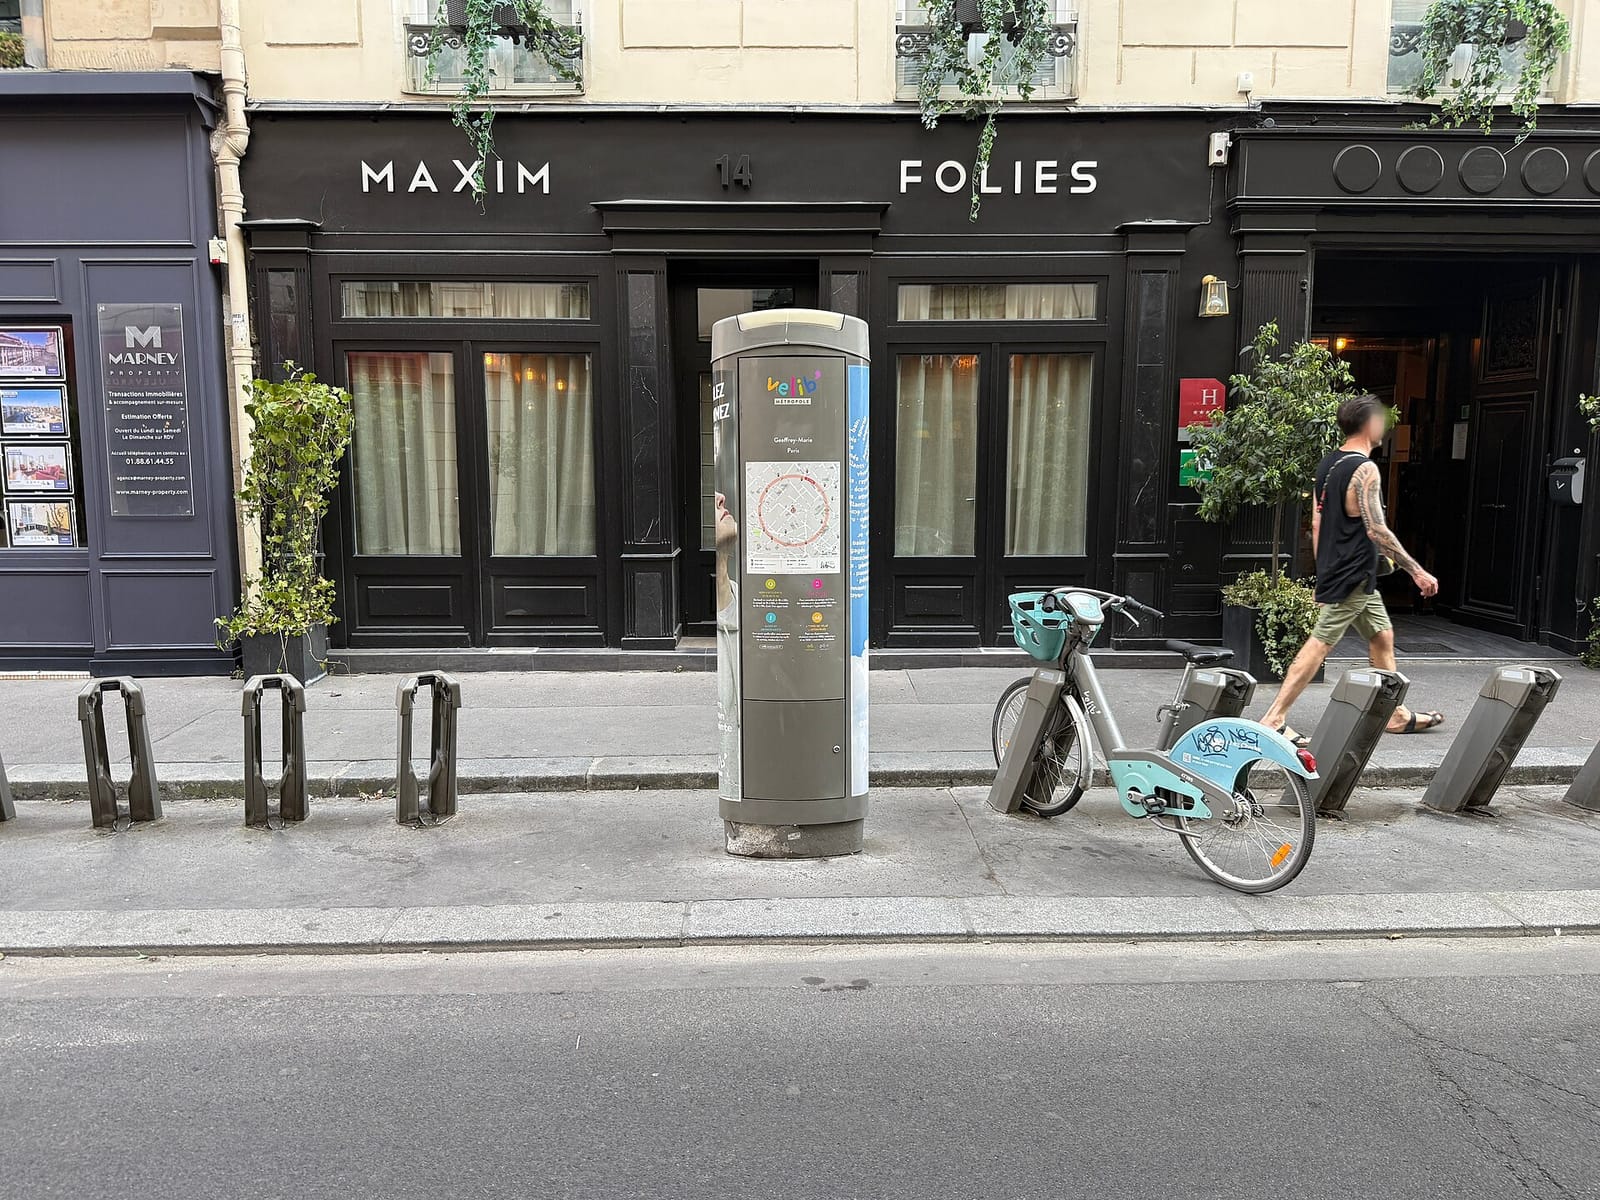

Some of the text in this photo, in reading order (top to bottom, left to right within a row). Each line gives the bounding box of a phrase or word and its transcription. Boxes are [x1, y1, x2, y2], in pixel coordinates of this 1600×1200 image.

[361, 160, 550, 194] MAXIM
[715, 153, 753, 187] 14
[900, 160, 1098, 194] FOLIES
[108, 352, 179, 365] MARNEY
[1201, 389, 1218, 405] H
